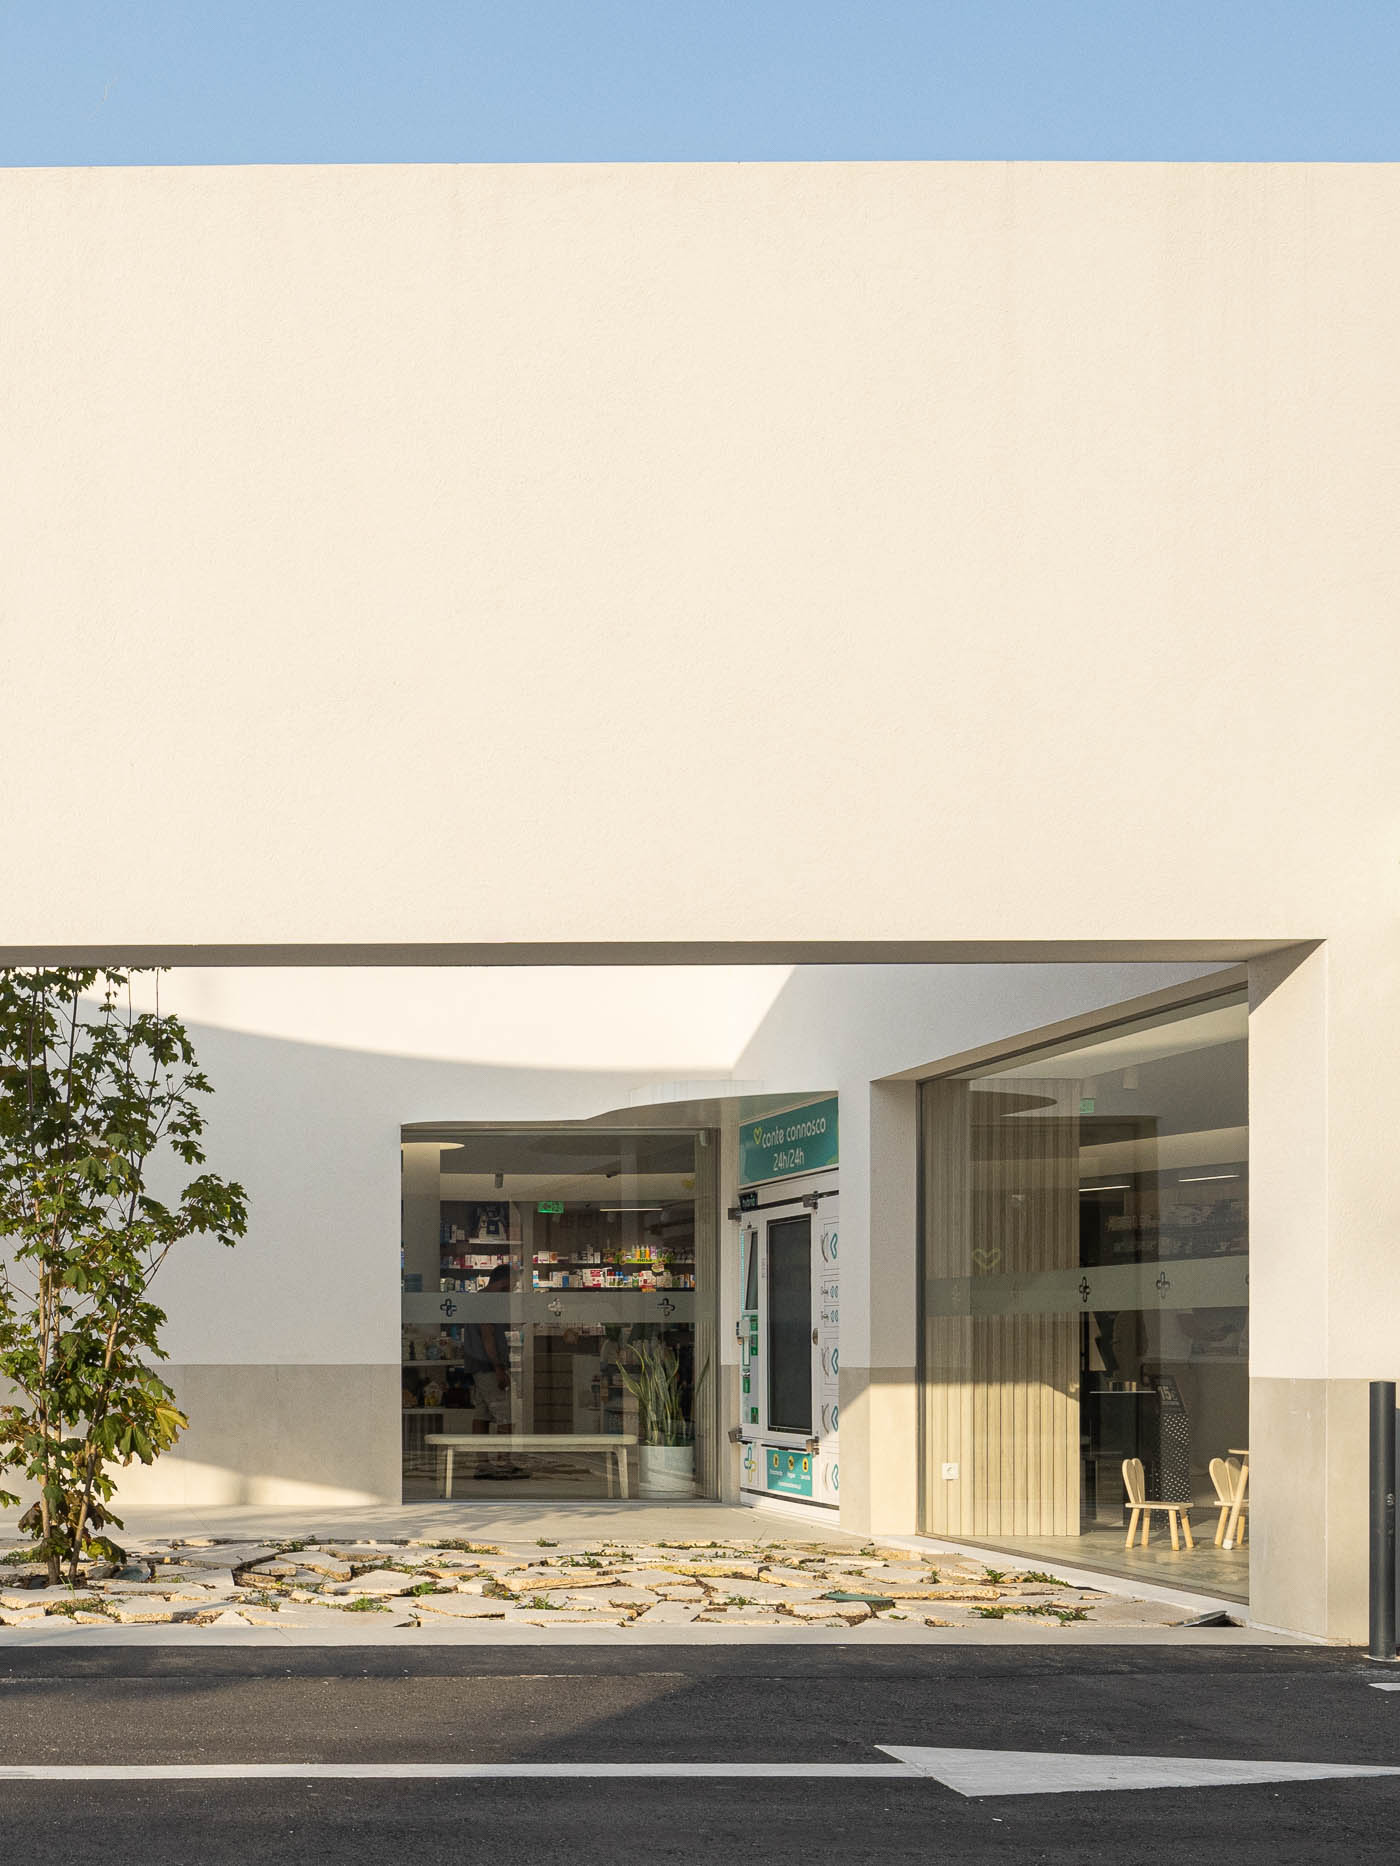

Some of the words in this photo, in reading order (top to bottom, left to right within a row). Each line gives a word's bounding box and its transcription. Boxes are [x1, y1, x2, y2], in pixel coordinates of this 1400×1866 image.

[762, 1126, 785, 1148] conte
[786, 1117, 826, 1141] connosco
[773, 1147, 805, 1171] 24h/24h
